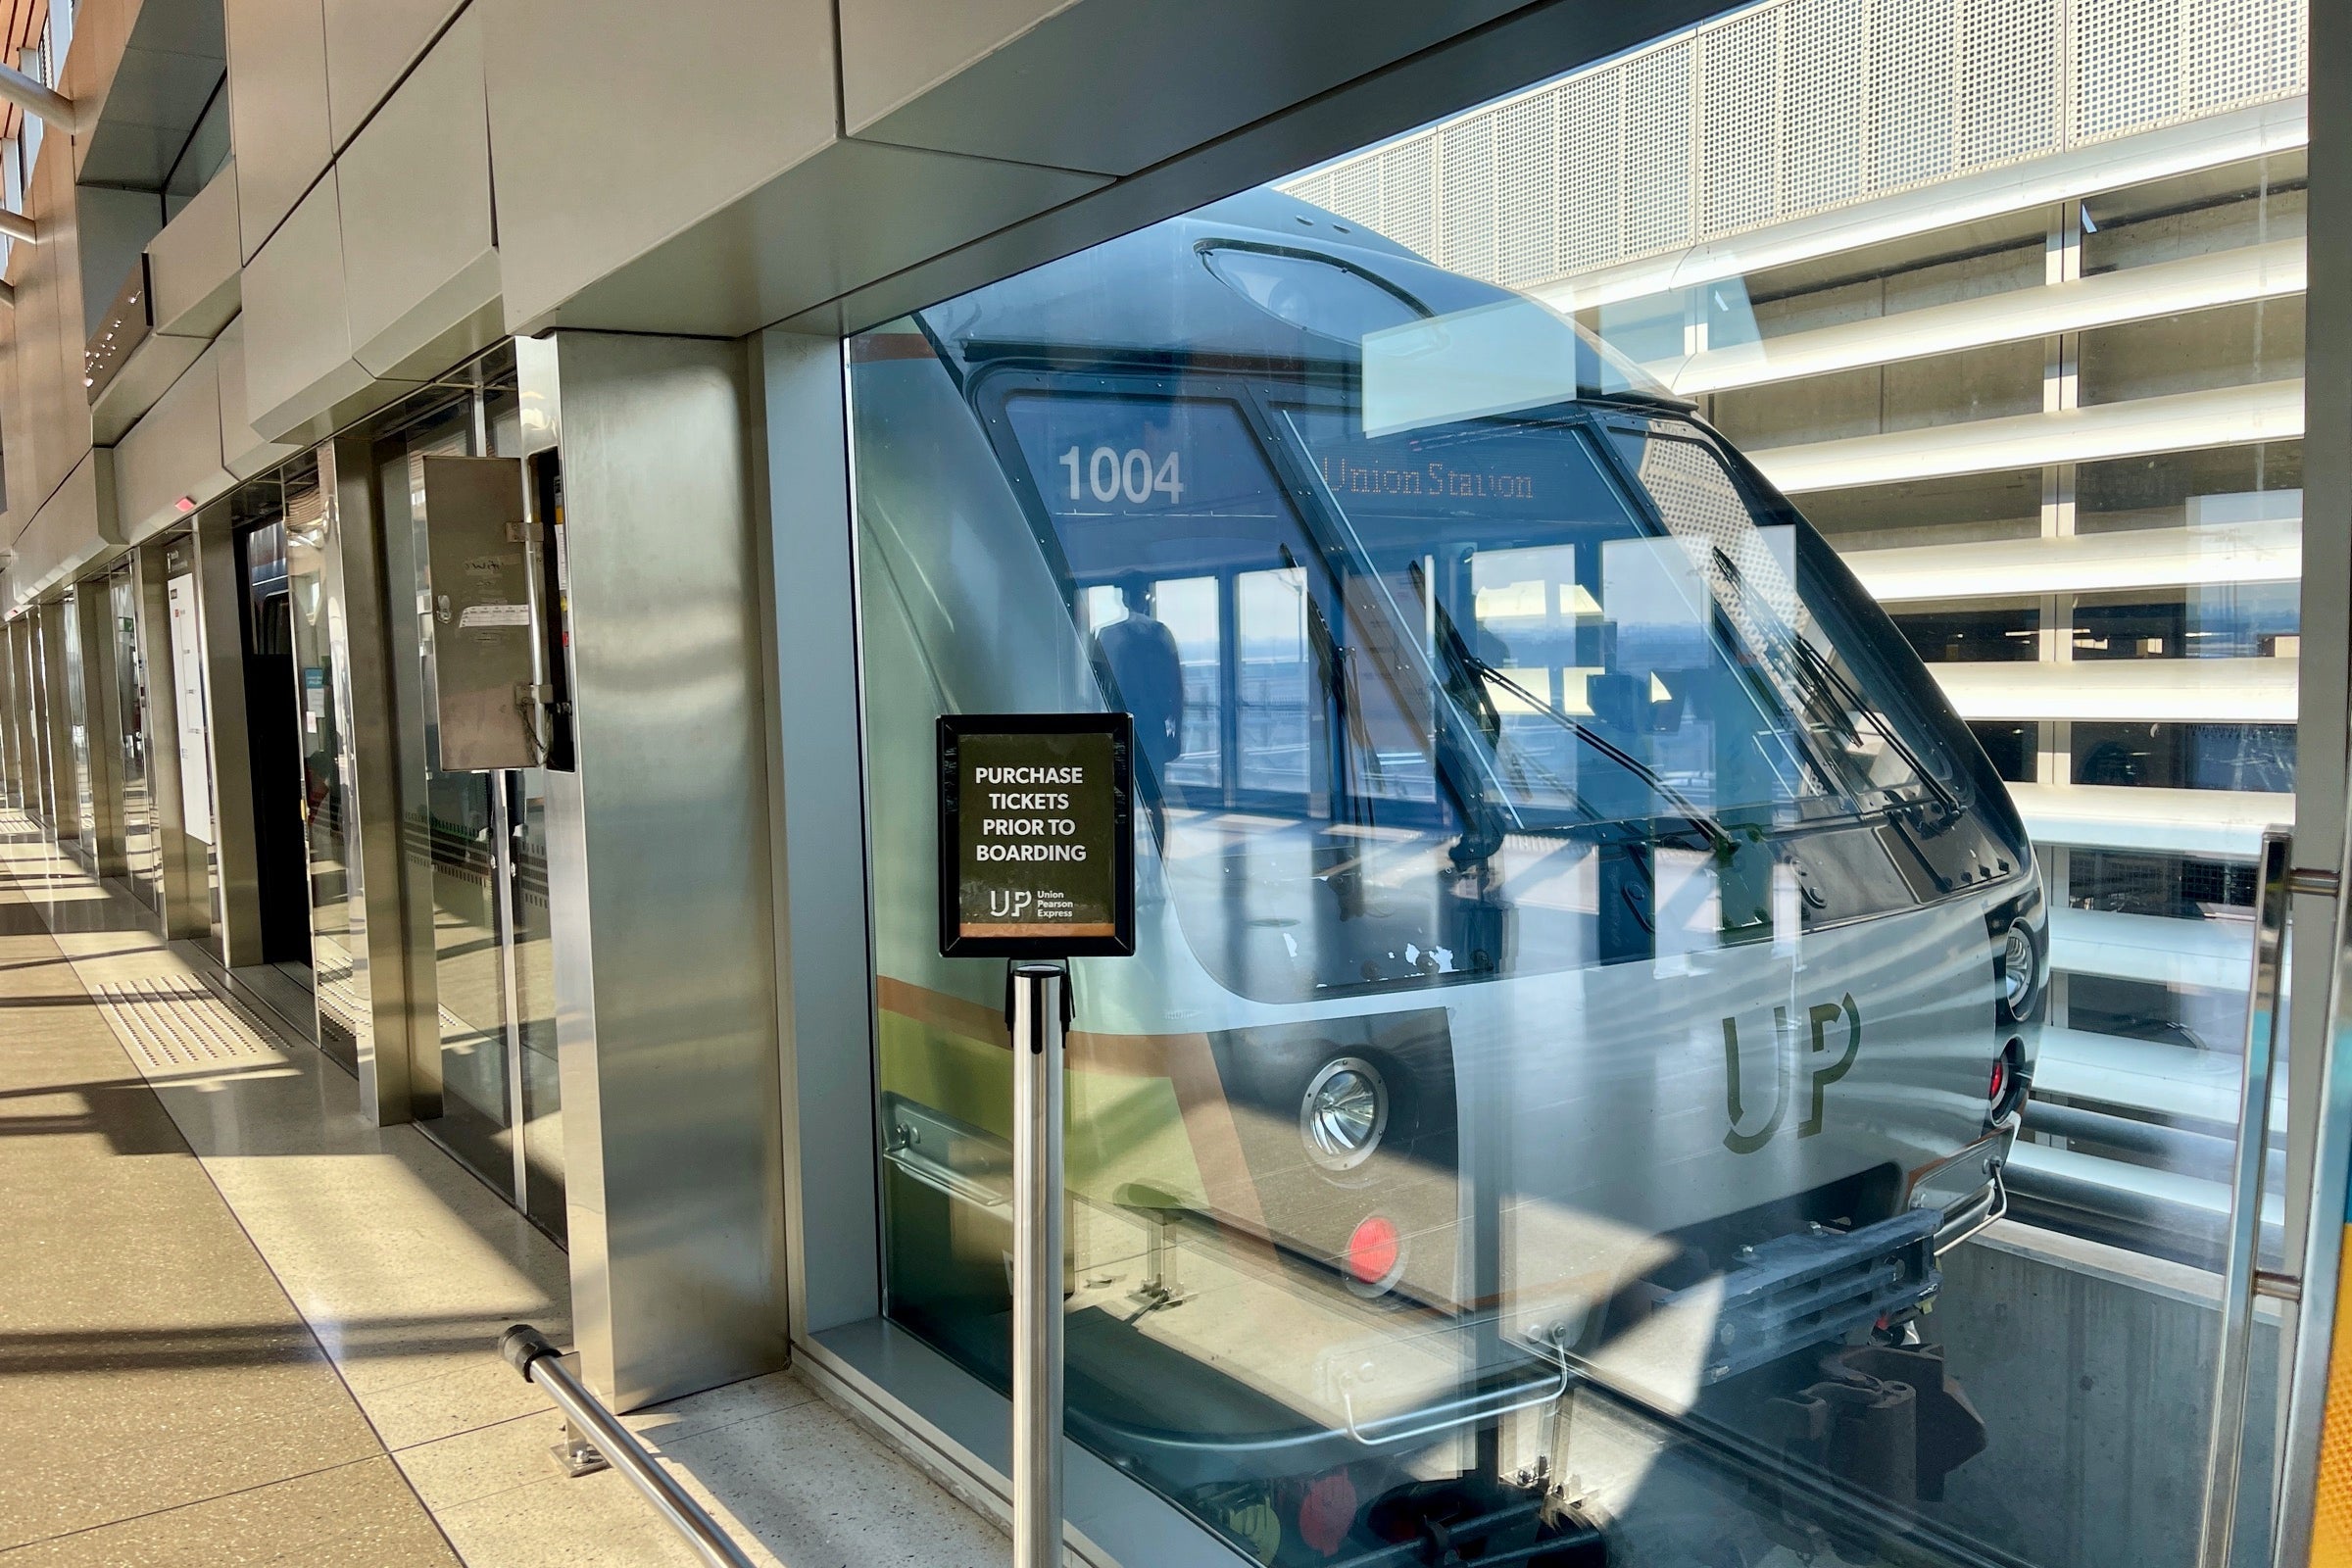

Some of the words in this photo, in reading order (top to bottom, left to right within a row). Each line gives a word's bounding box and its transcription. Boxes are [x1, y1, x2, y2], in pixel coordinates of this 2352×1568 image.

[1058, 445, 1185, 505] 1004
[1324, 457, 1422, 494] Union
[975, 766, 1084, 784] PURCHASE
[988, 793, 1070, 810] TICKETS
[983, 818, 1045, 836] PRIOR
[1047, 818, 1077, 836] TO
[976, 844, 1087, 861] BOARDING
[990, 890, 1032, 917] UP
[1037, 890, 1065, 899] Union
[1037, 900, 1074, 908] Pearson
[1037, 909, 1073, 918] Express
[1722, 992, 1861, 1154] UP
